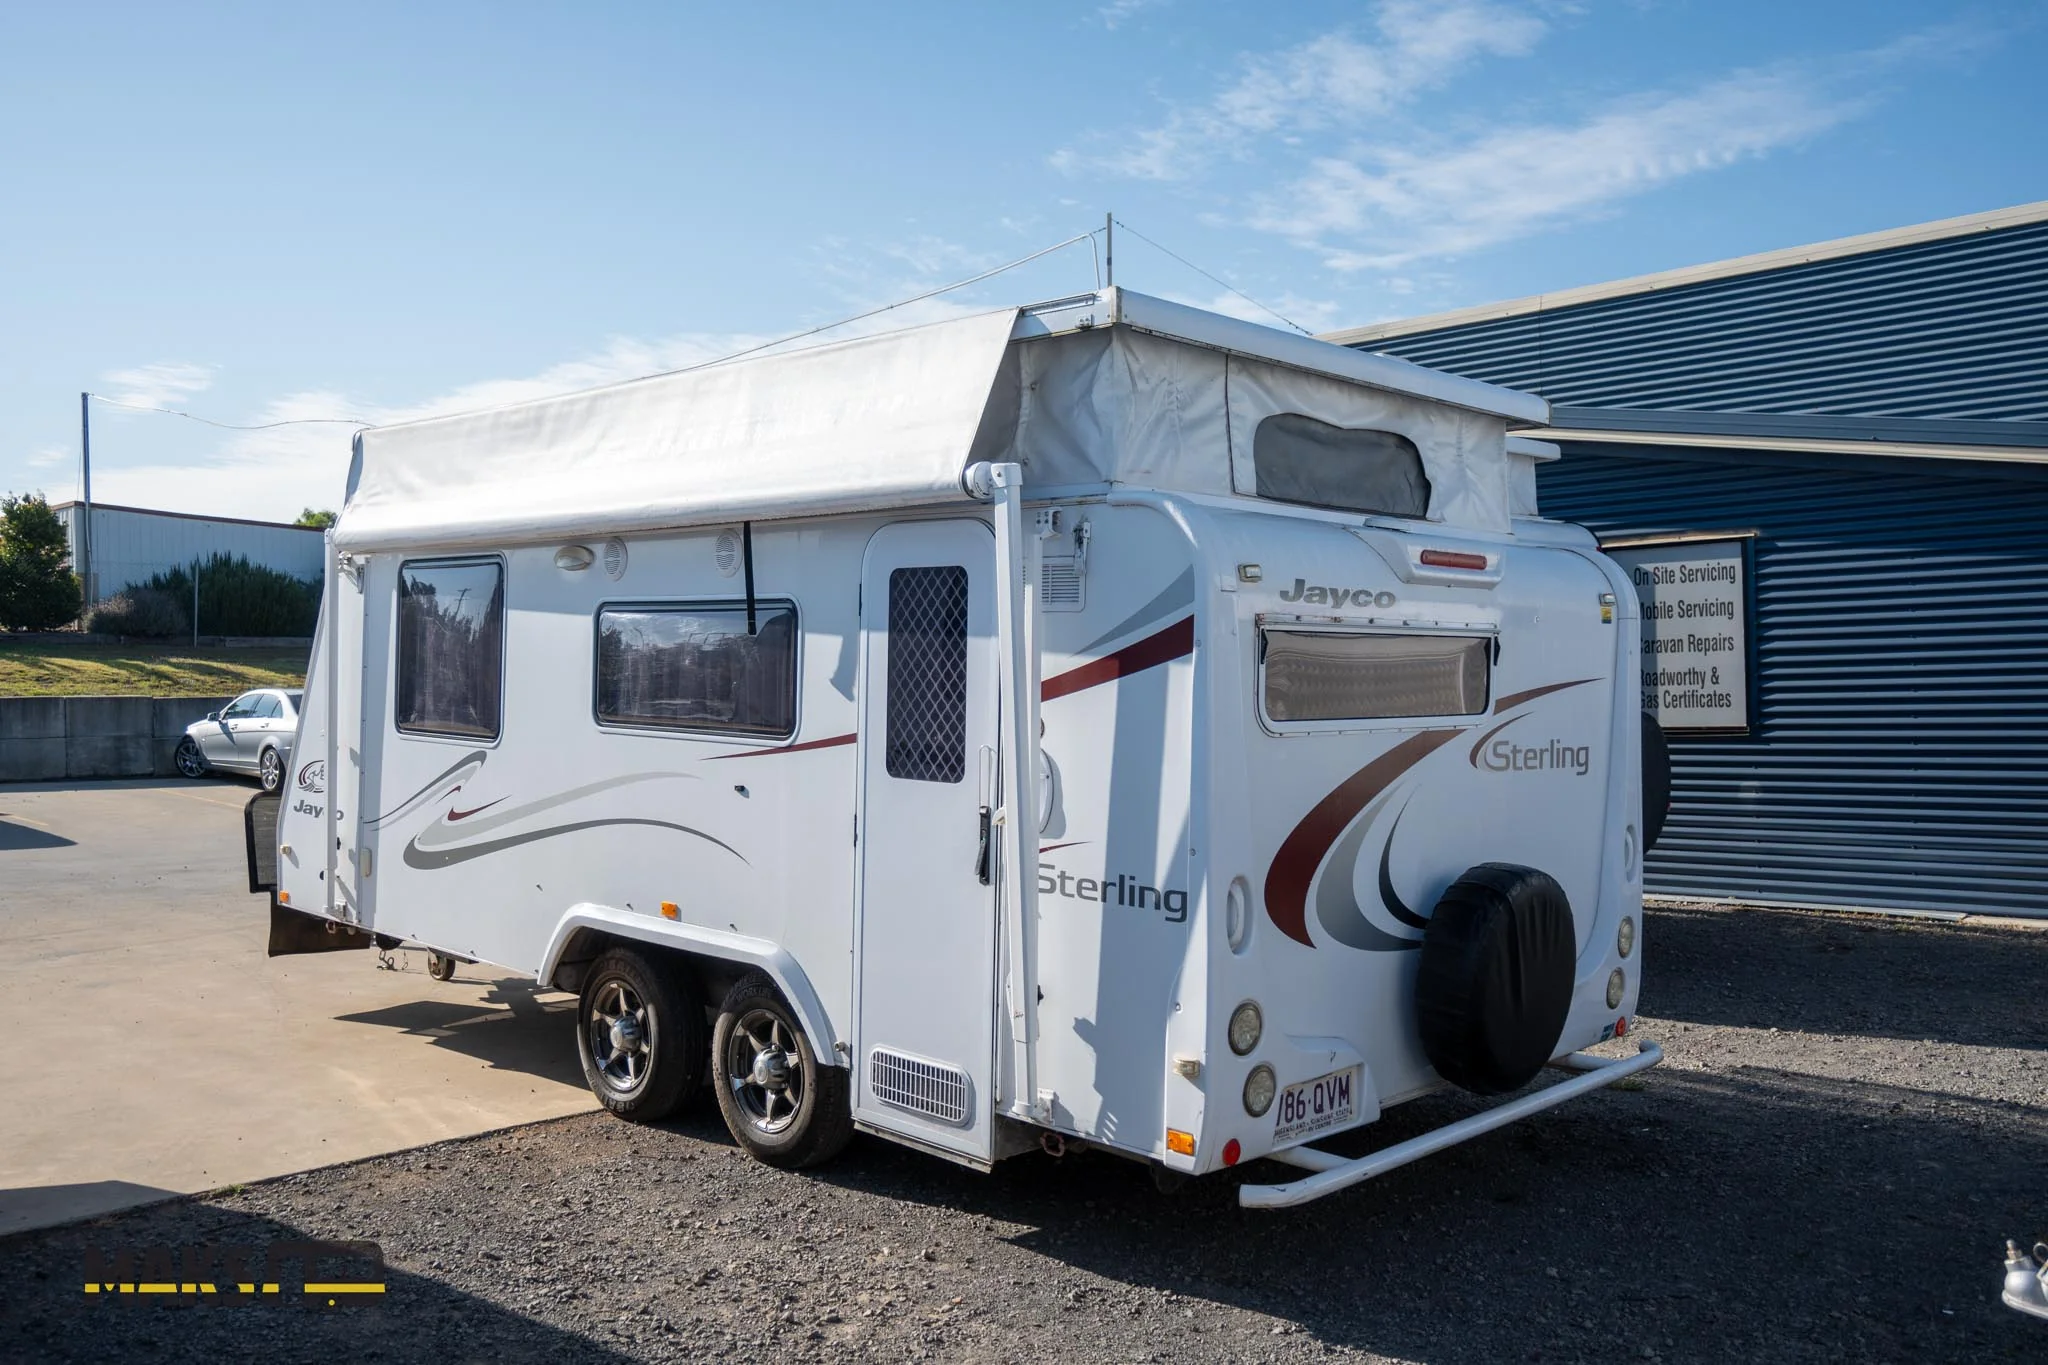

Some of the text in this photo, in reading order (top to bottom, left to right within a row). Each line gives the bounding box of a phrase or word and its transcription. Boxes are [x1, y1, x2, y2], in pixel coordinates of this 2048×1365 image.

[1634, 563, 1736, 586] On Site Servicing
[1280, 578, 1396, 609] Jayco
[1678, 598, 1733, 620] Servicing
[1687, 632, 1734, 657] Repairs
[1711, 666, 1720, 685] &
[1663, 690, 1732, 709] Certificates
[1491, 739, 1590, 776] Sterling
[293, 799, 345, 821] Jayo
[1038, 863, 1188, 924] Sterling
